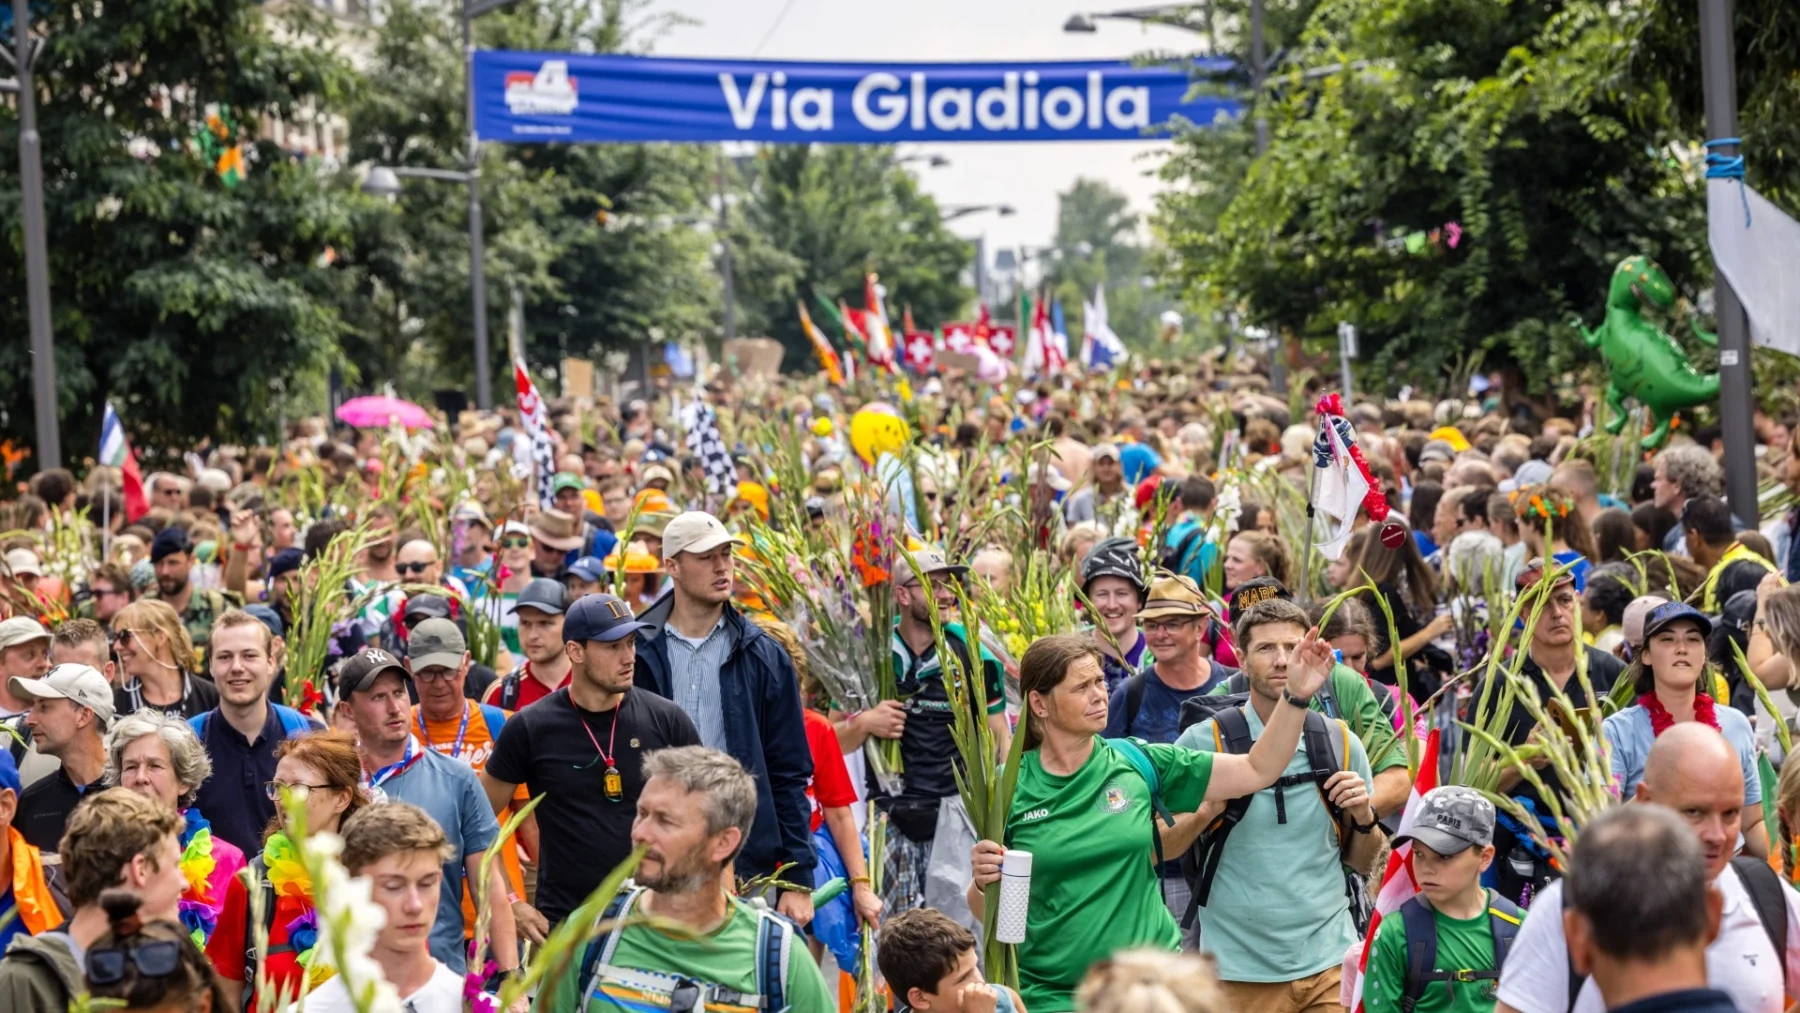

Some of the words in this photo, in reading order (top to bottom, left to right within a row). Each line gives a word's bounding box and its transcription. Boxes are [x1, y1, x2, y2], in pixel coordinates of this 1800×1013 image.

[718, 71, 834, 131] Via
[851, 70, 1150, 132] Gladiola
[366, 650, 388, 664] NY
[1022, 808, 1049, 822] JAKO
[1437, 814, 1462, 830] PARIS
